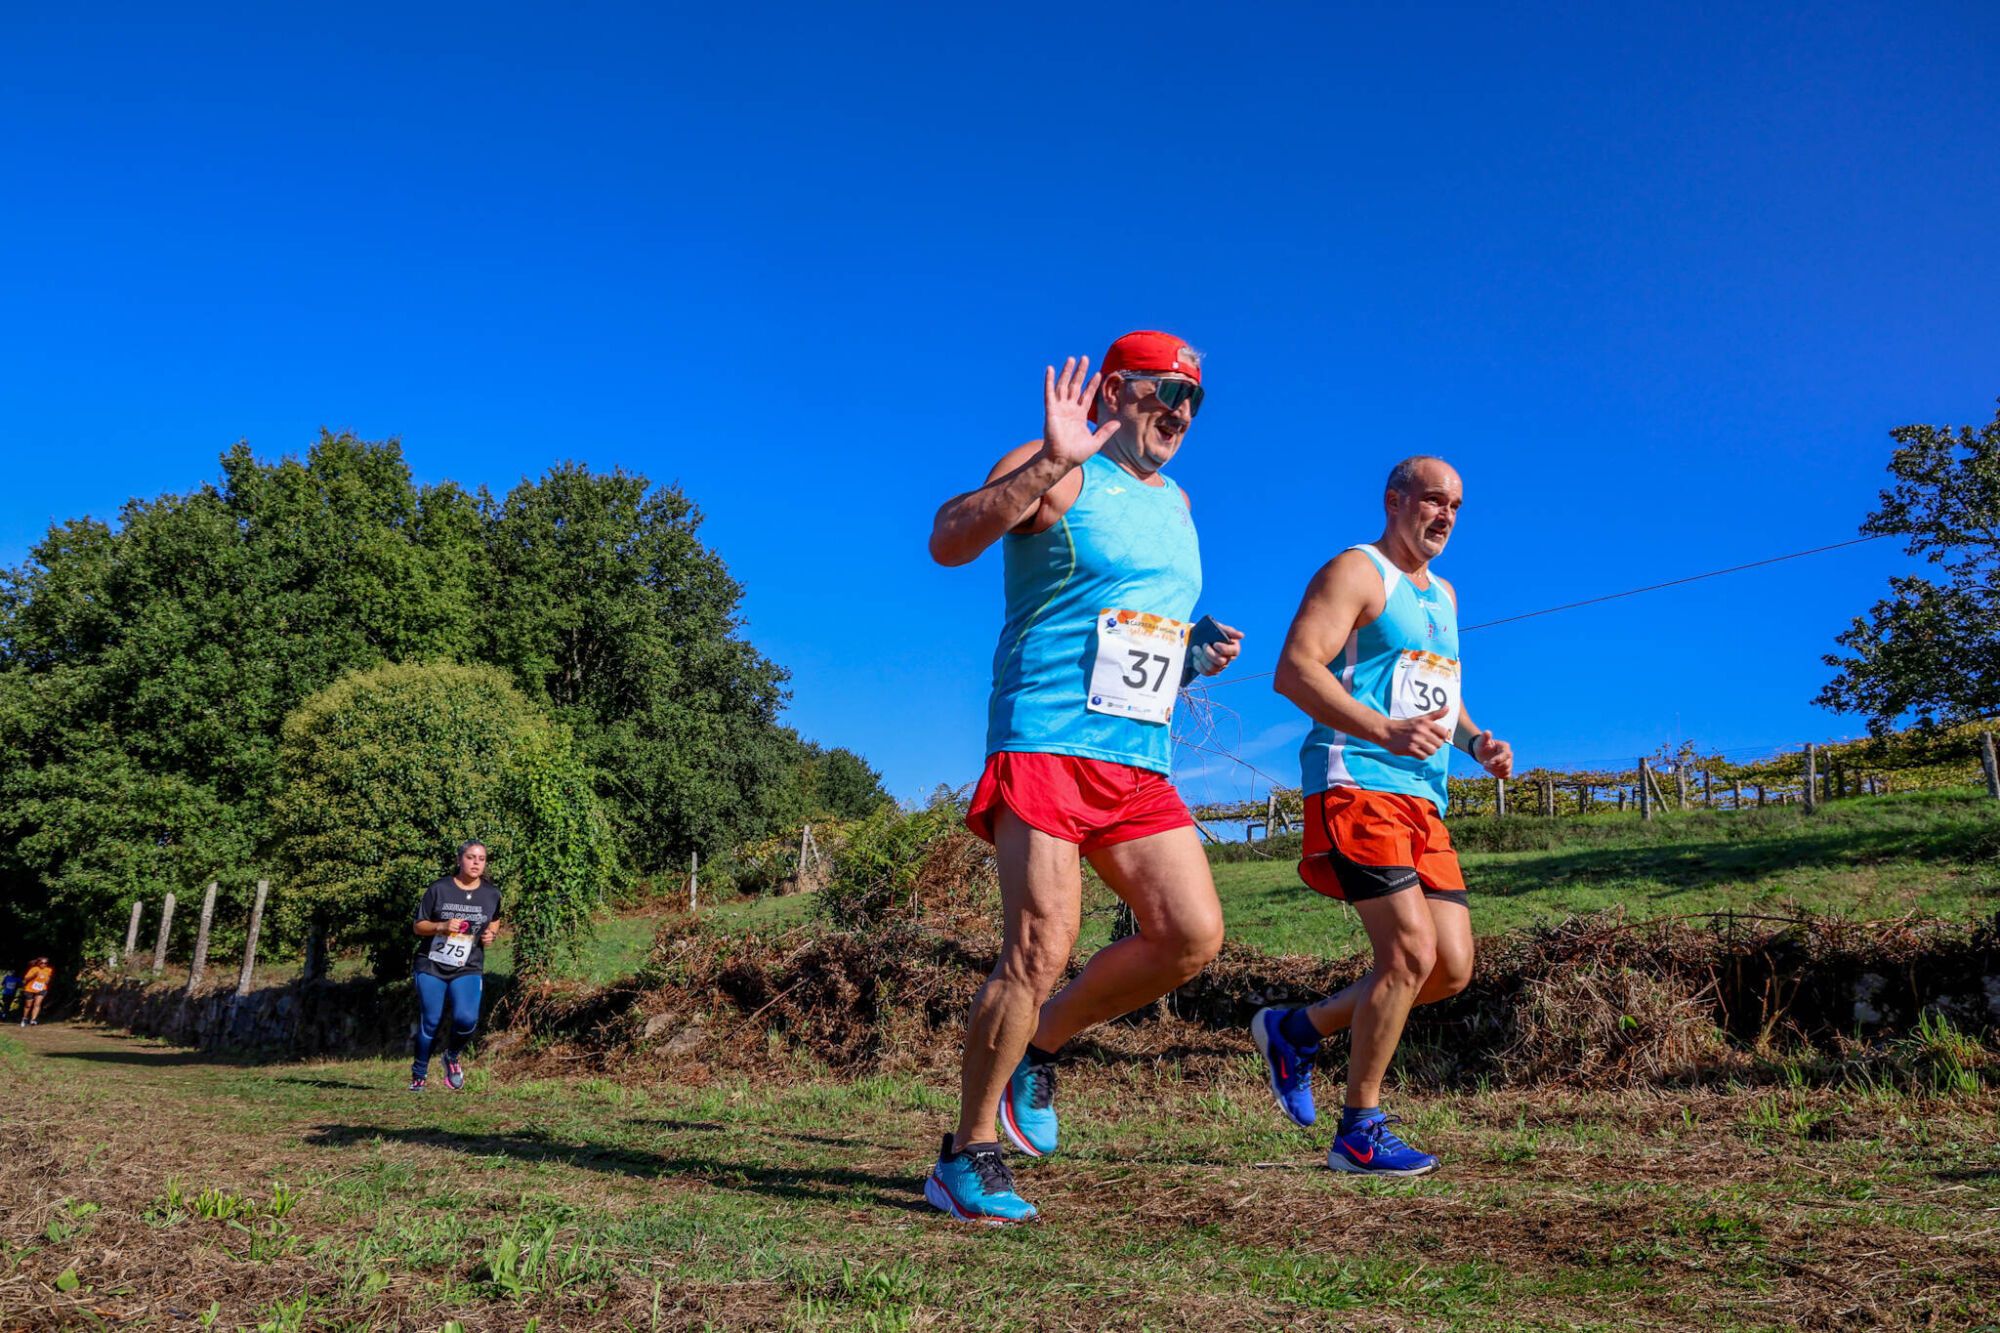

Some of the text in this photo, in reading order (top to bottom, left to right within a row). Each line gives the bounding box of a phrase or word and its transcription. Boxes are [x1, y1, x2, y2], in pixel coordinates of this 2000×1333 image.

[1122, 649, 1170, 693] 37
[1414, 680, 1447, 711] 39
[435, 942, 465, 958] 275
